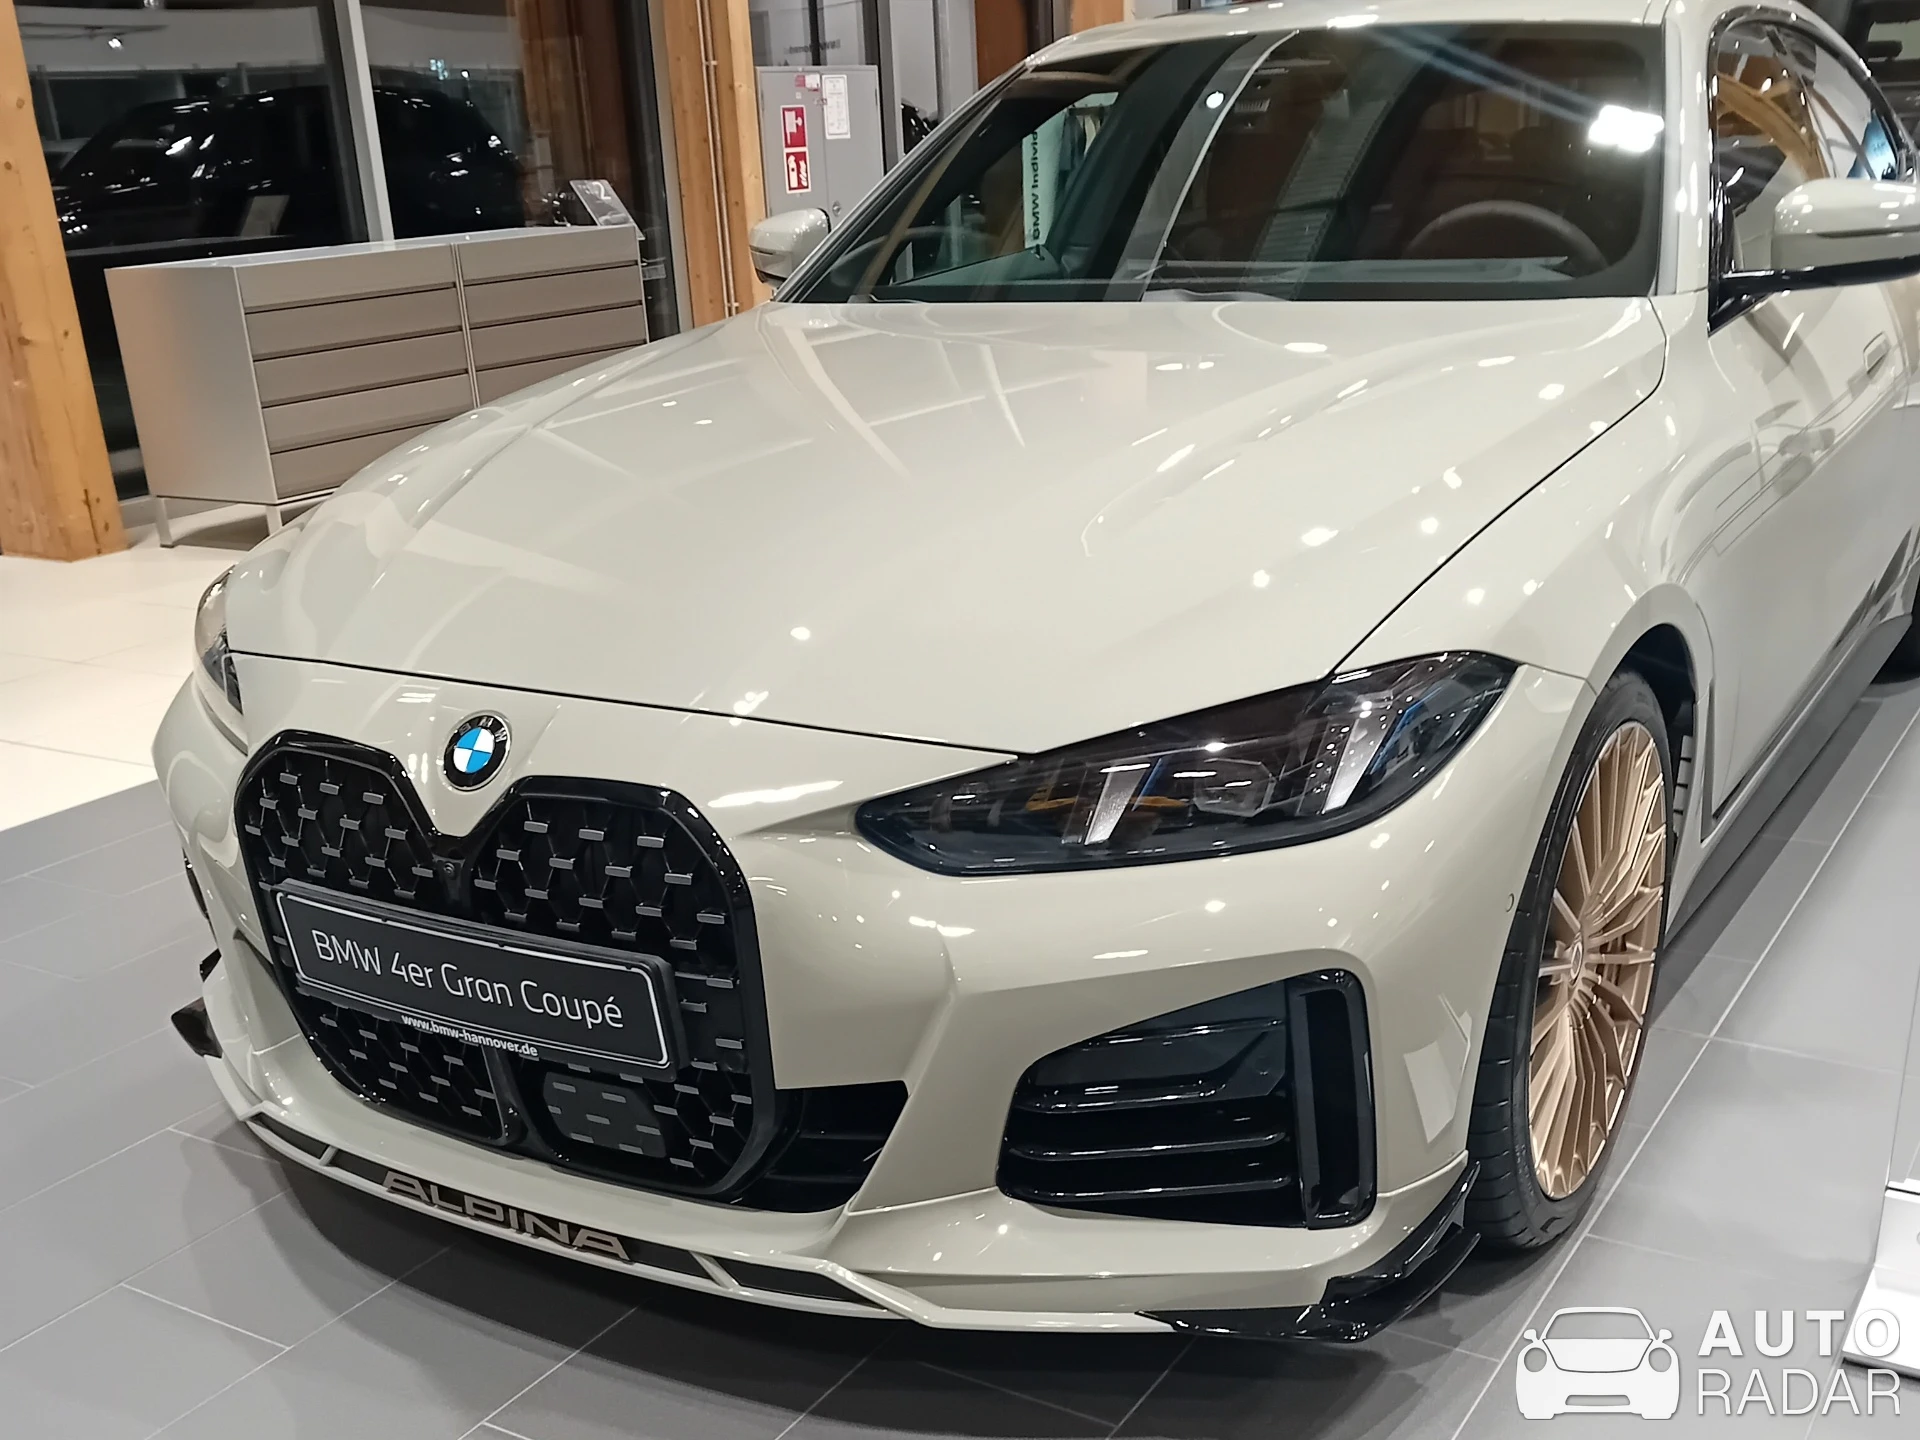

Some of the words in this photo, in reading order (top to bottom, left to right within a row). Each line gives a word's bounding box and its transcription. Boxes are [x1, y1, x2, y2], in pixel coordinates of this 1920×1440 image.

[1031, 192, 1041, 240] BMW
[459, 716, 507, 743] BMW
[311, 929, 381, 976] BMW
[391, 952, 434, 989] 4er
[441, 963, 514, 1007] Gran
[520, 980, 624, 1029] Coupé
[401, 1015, 539, 1057] www.bmw-hannover.de
[382, 1170, 631, 1262] ALPINA
